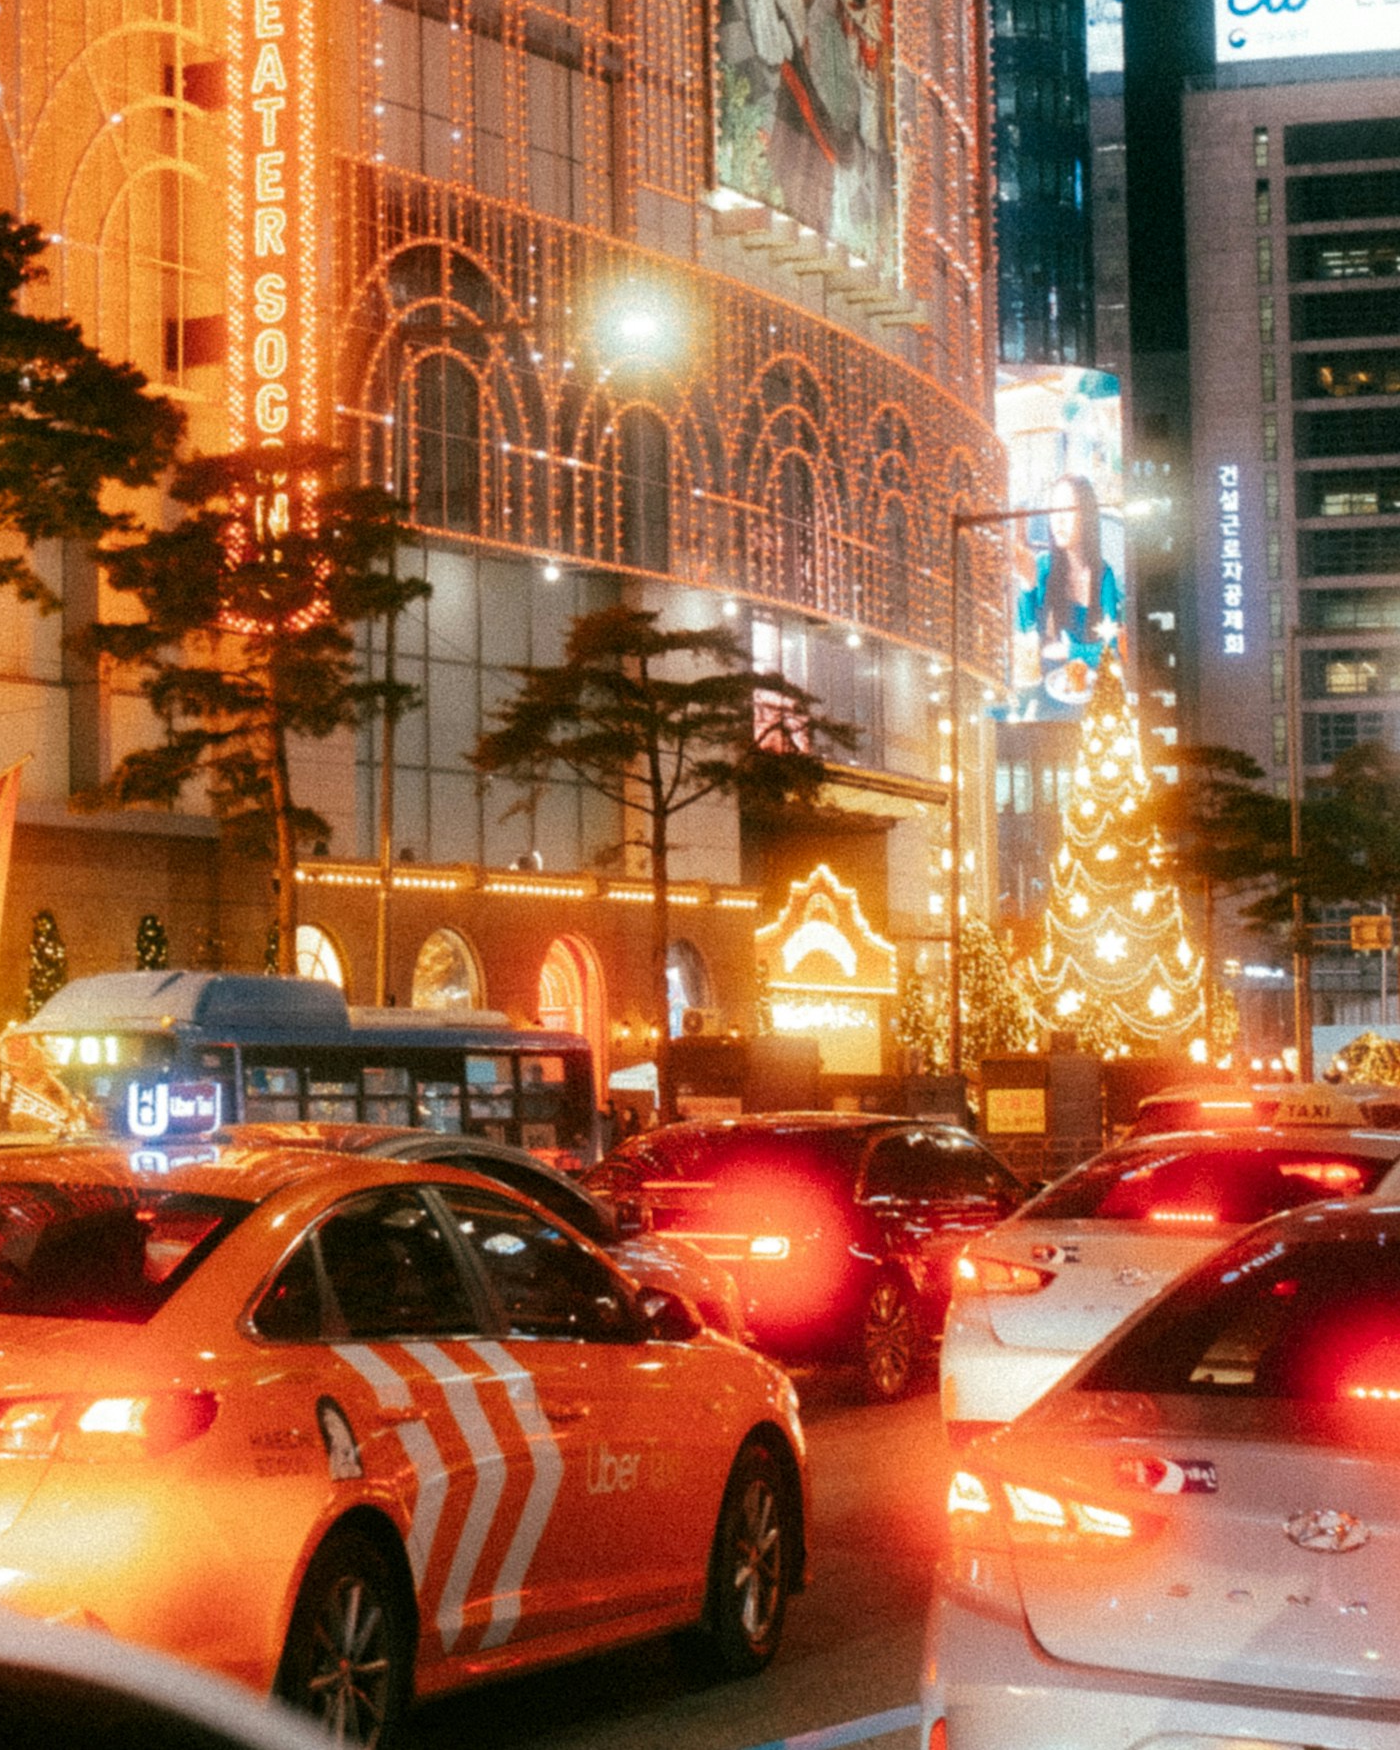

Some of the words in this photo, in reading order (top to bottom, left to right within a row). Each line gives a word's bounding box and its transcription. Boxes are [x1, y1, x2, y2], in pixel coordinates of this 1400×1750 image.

[1218, 463, 1246, 655] 건설근로자공제회
[1286, 1104, 1331, 1119] TAXI
[587, 1442, 642, 1495] Uber
